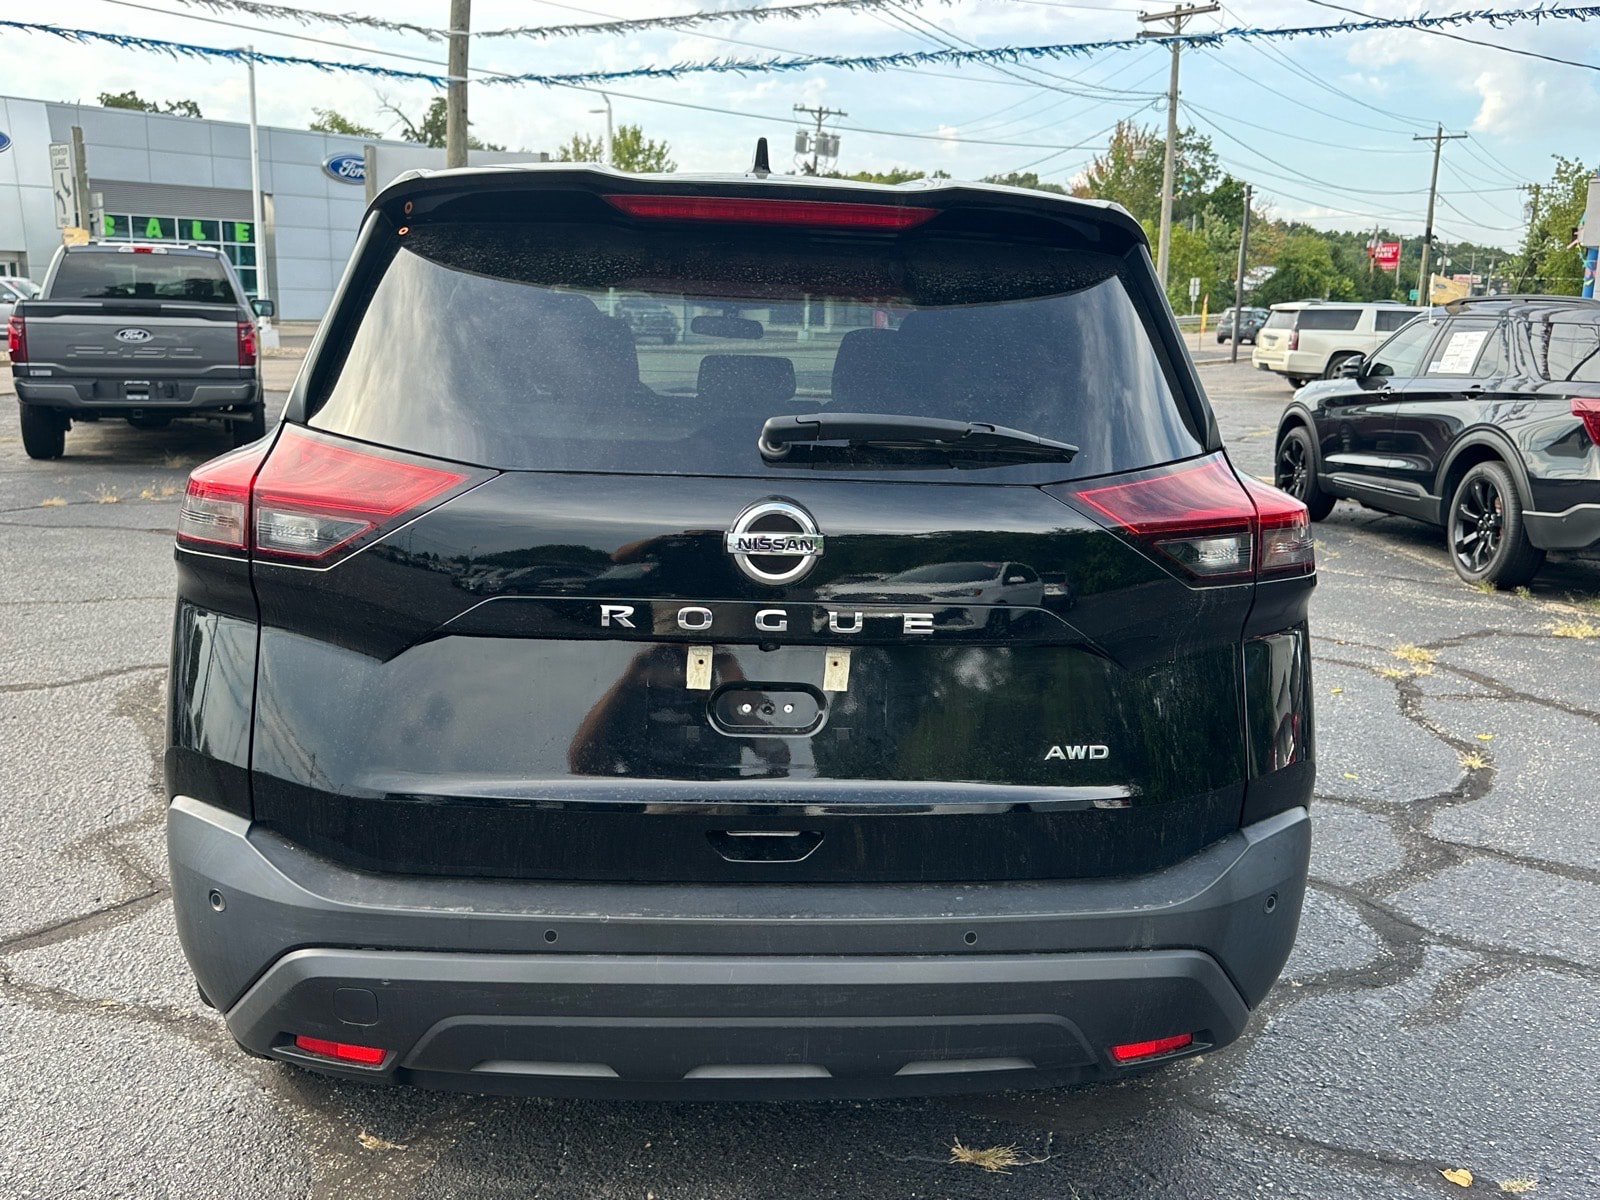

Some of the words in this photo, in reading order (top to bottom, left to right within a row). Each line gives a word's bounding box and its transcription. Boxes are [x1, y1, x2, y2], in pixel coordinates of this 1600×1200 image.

[338, 159, 366, 178] For
[737, 537, 815, 552] NISSAN
[600, 604, 935, 636] ROGUE
[1044, 745, 1109, 760] AWD
